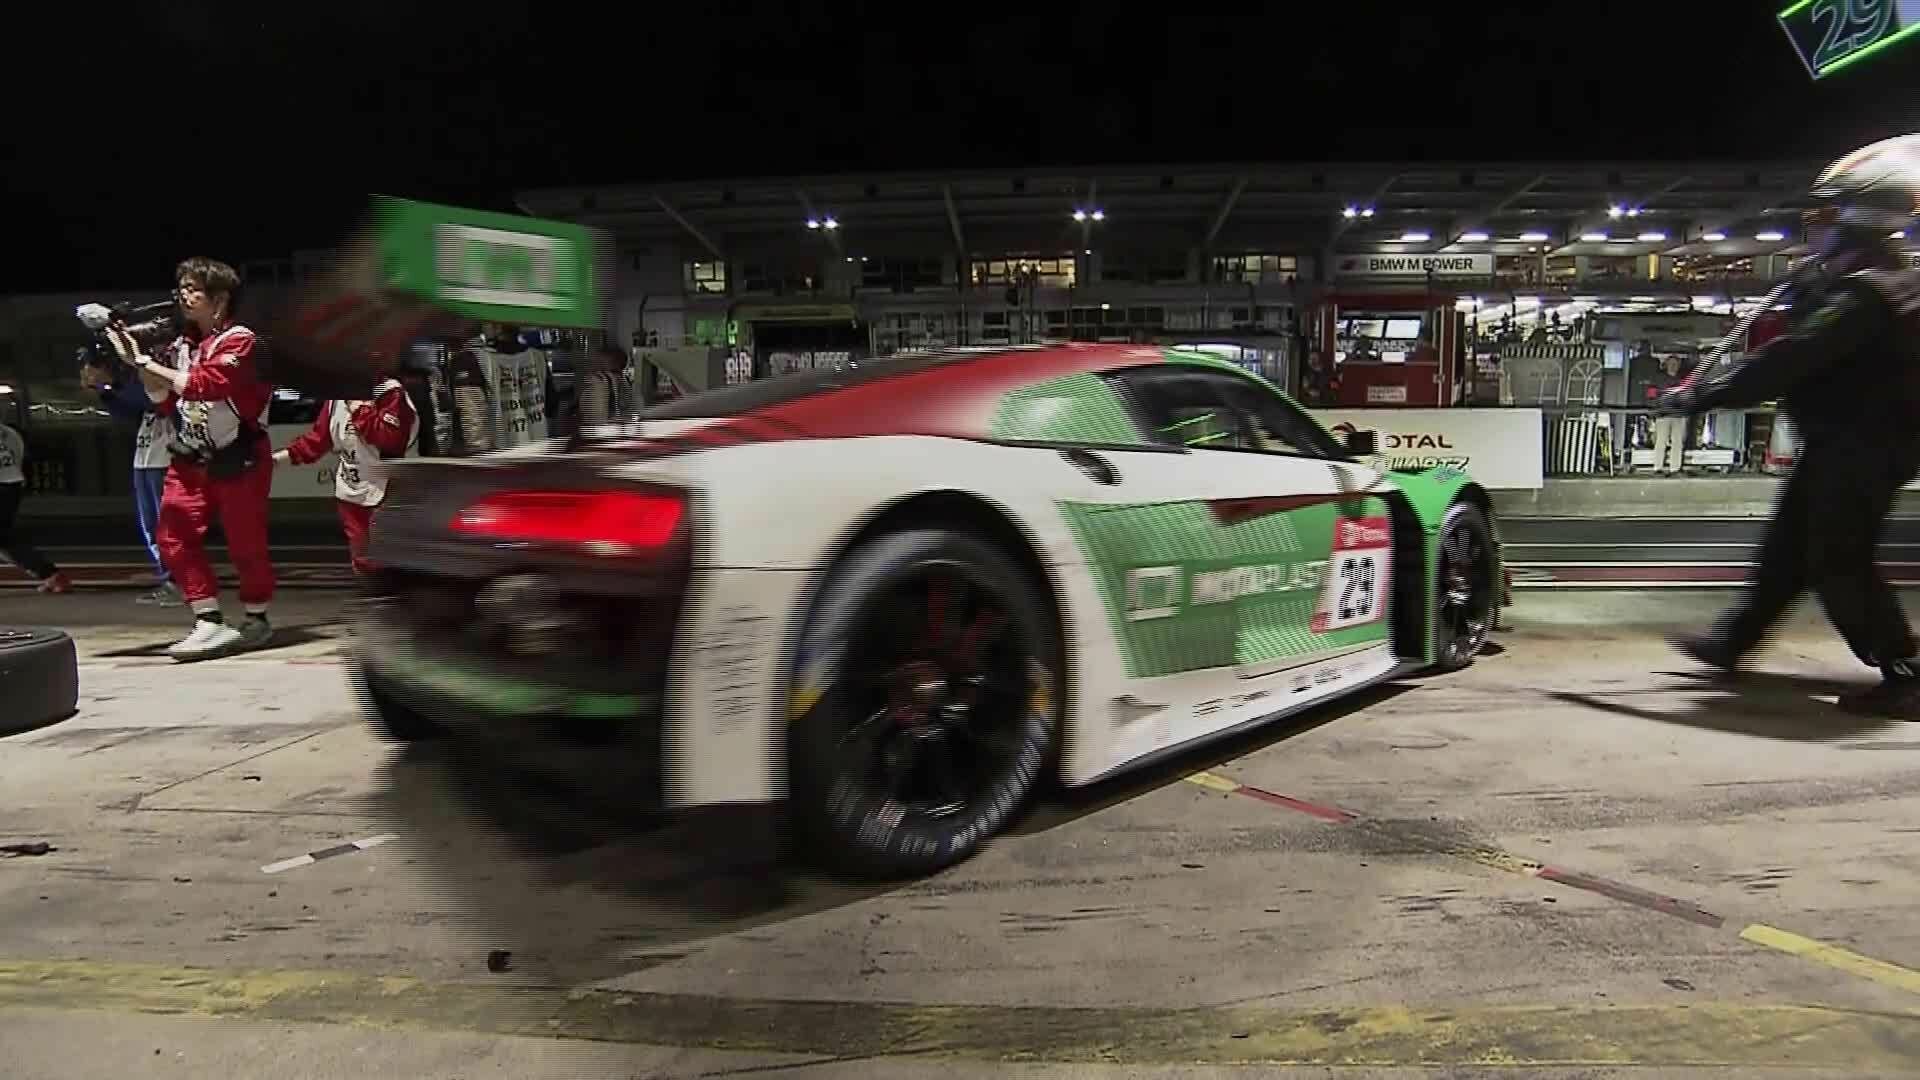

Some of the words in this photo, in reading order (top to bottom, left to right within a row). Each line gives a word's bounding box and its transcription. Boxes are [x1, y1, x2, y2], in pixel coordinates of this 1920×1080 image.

[1812, 0, 1893, 70] 29
[1370, 258, 1404, 271] BMW
[1407, 258, 1420, 270] M
[1422, 257, 1474, 271] POWER
[1386, 434, 1454, 449] OTAL
[1337, 556, 1376, 621] 29
